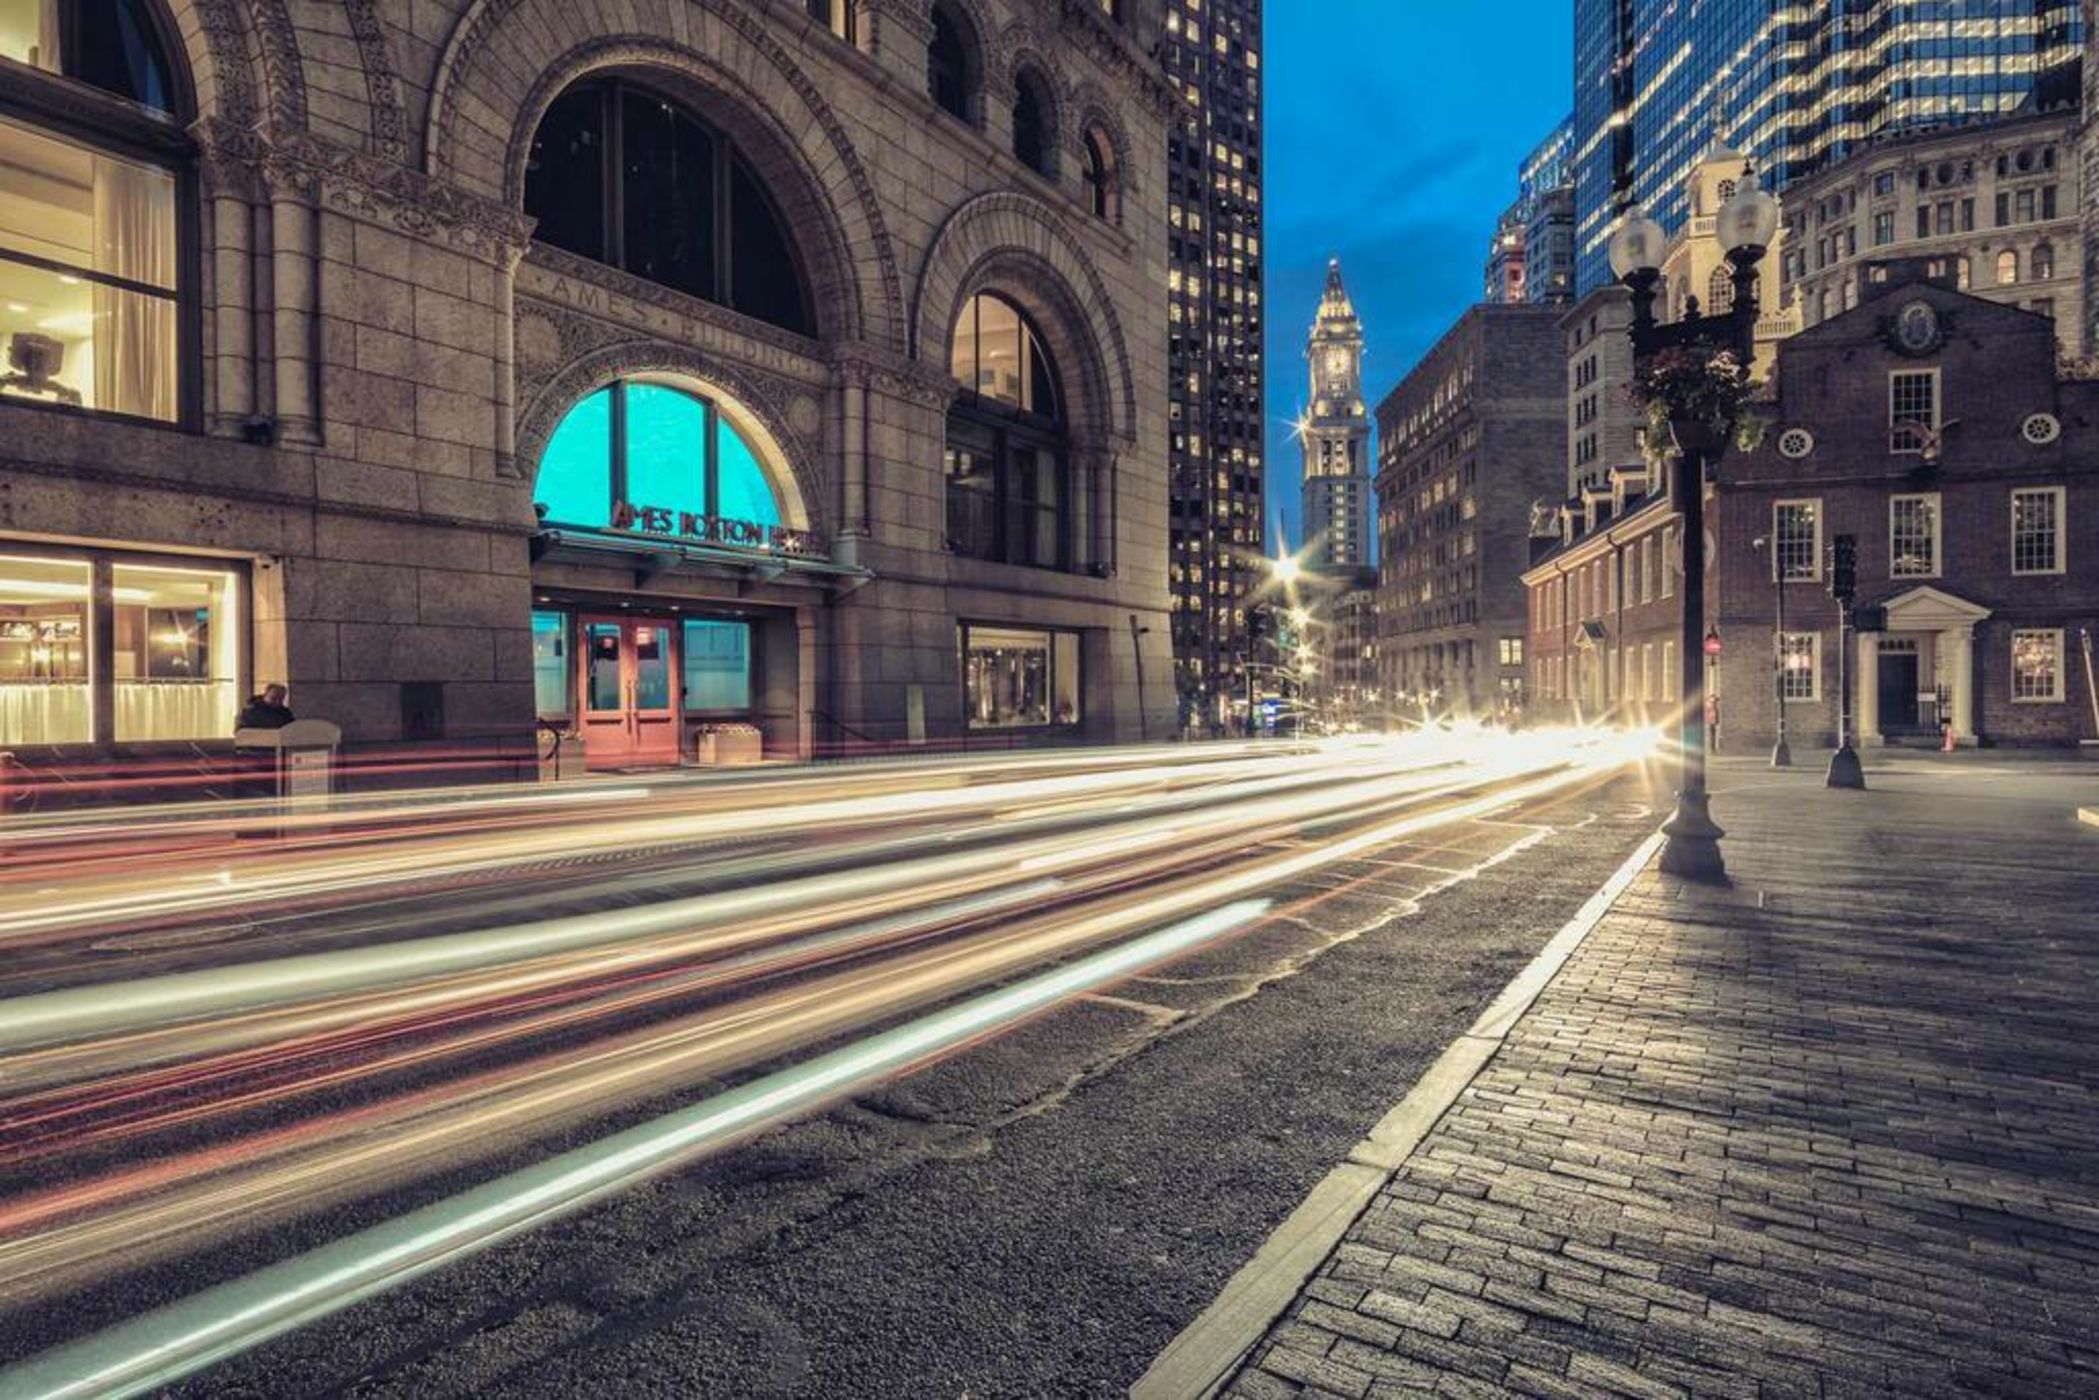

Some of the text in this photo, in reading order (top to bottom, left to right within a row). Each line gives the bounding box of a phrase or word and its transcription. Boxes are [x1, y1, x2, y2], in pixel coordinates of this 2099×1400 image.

[551, 277, 801, 373] AMES BUILDING
[611, 499, 673, 532] AMES
